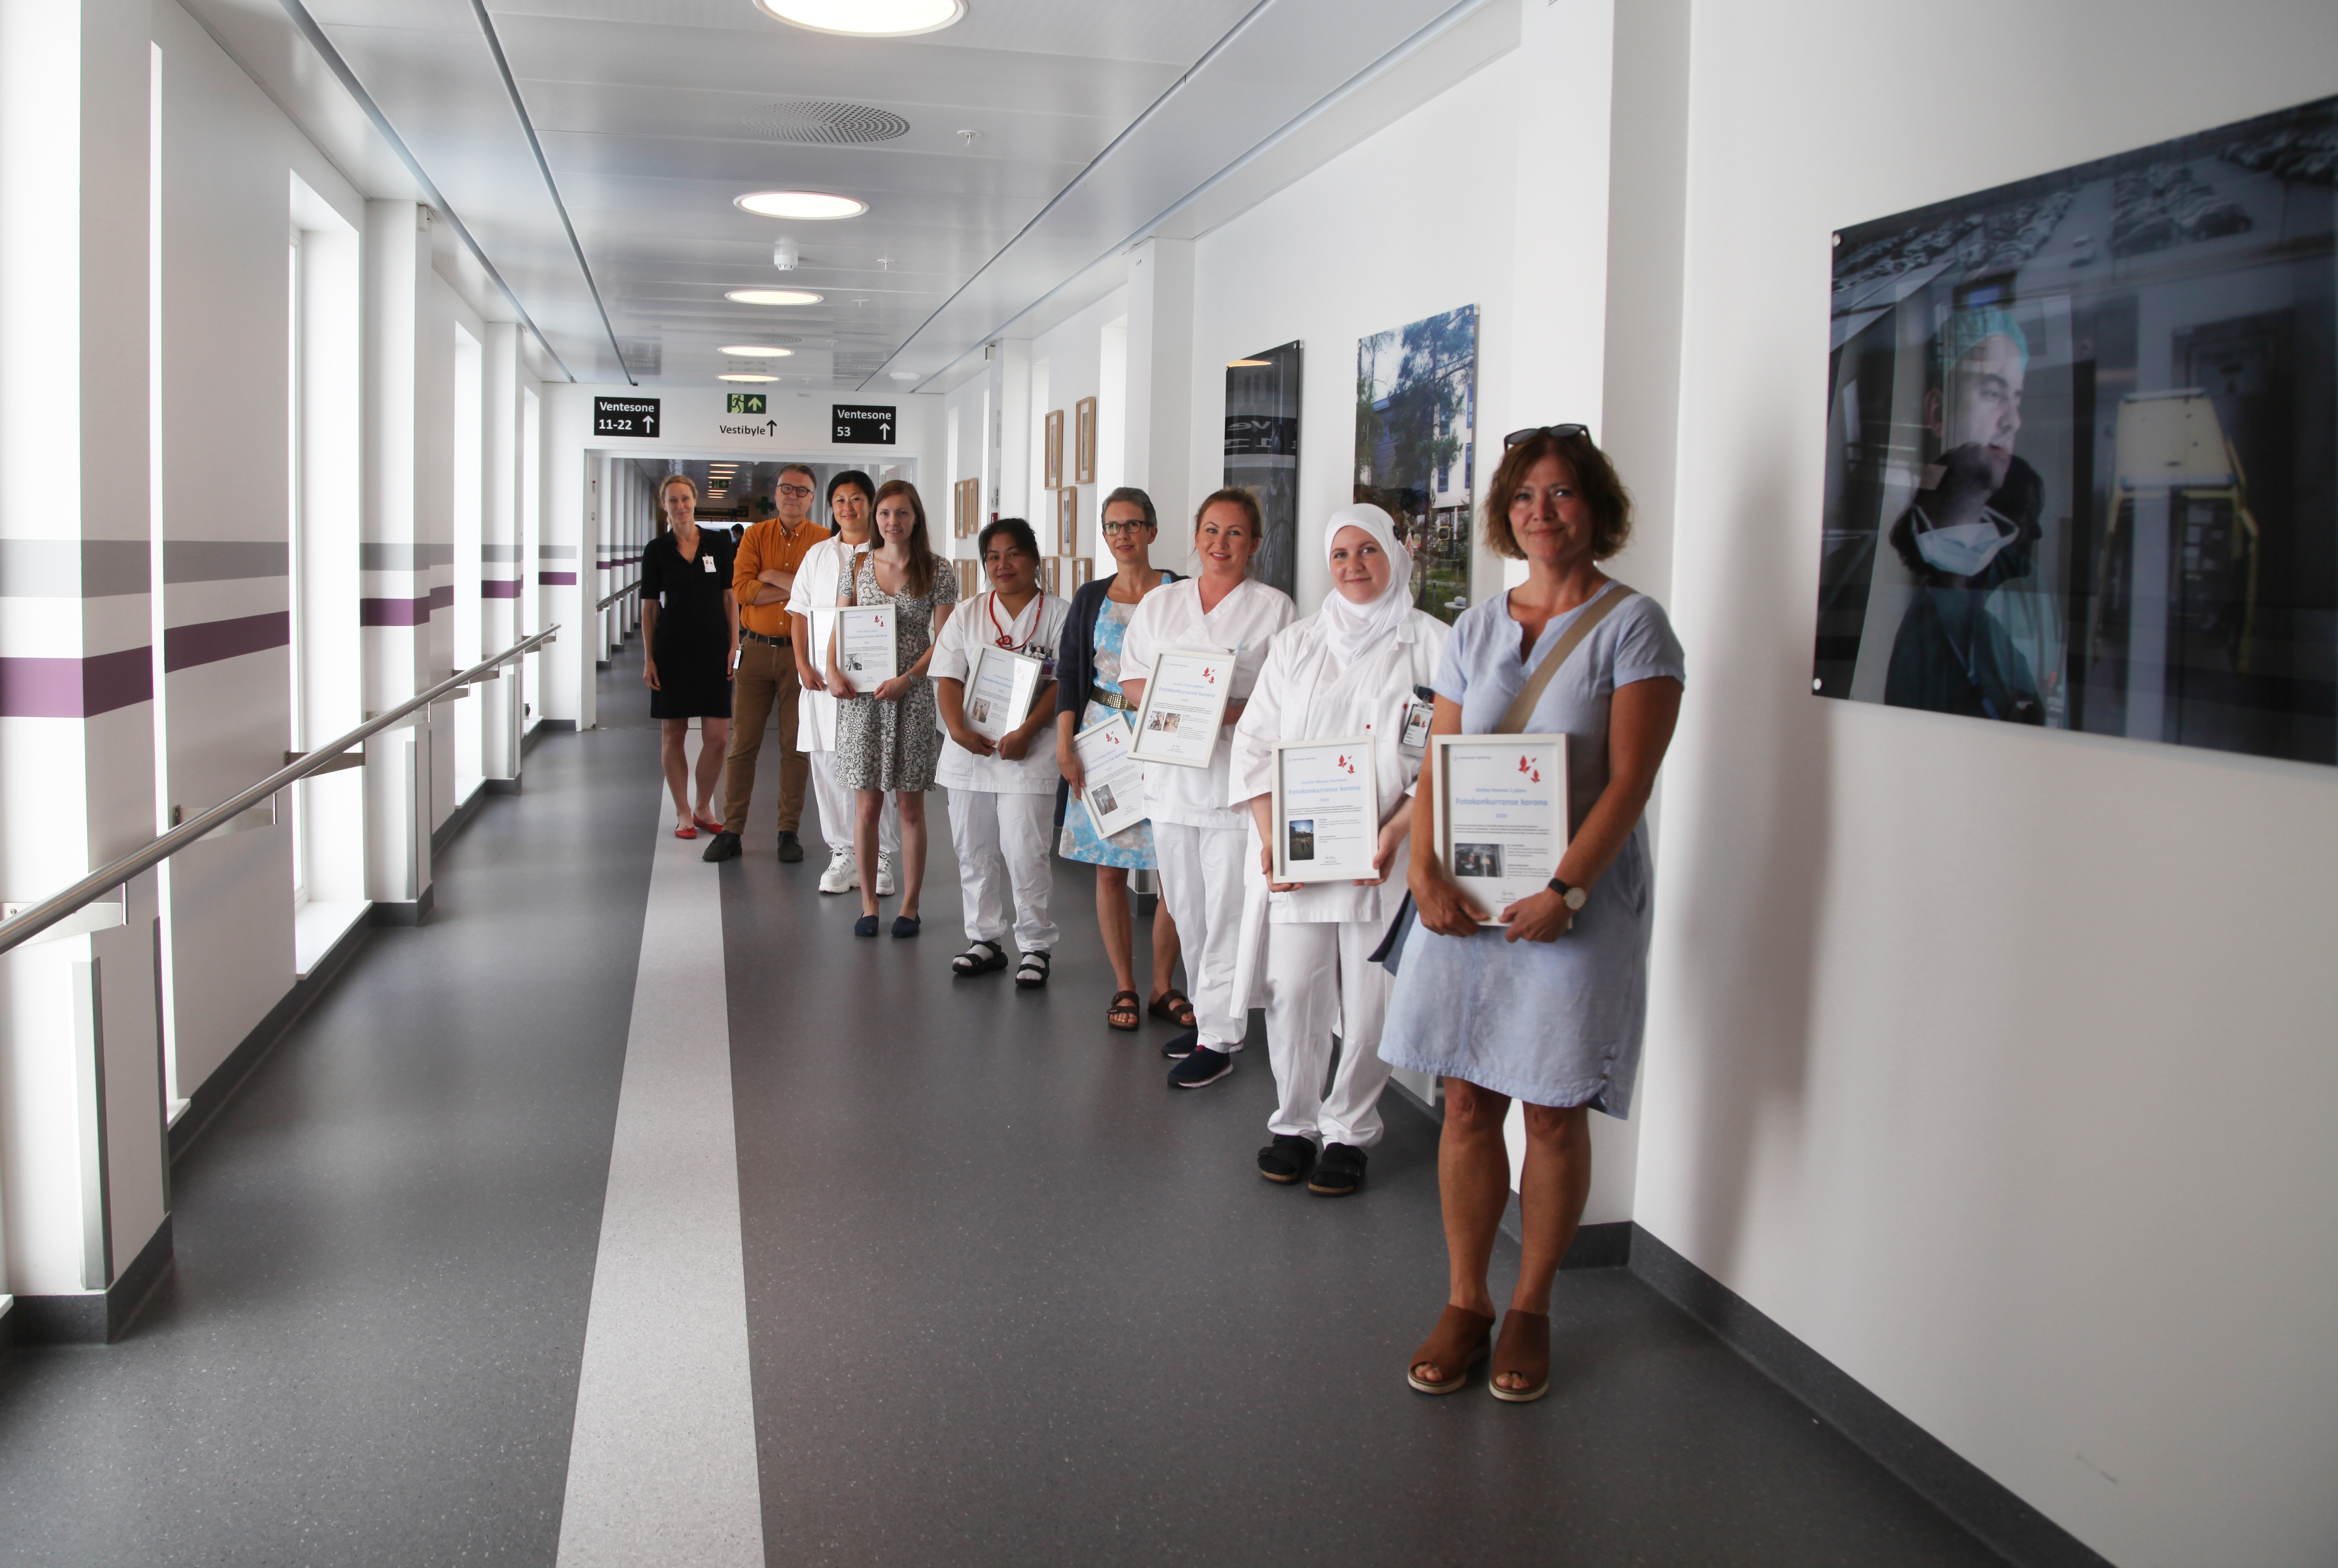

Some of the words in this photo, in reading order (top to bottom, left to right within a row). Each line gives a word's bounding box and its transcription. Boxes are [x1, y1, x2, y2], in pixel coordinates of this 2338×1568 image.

[600, 402, 654, 412] Ventesone
[837, 409, 891, 420] Ventesone
[599, 419, 632, 430] 11-22
[720, 425, 765, 436] Vestibyle
[837, 426, 851, 437] 53
[1159, 687, 1198, 696] Fotokonkurranse
[1115, 749, 1128, 759] korona
